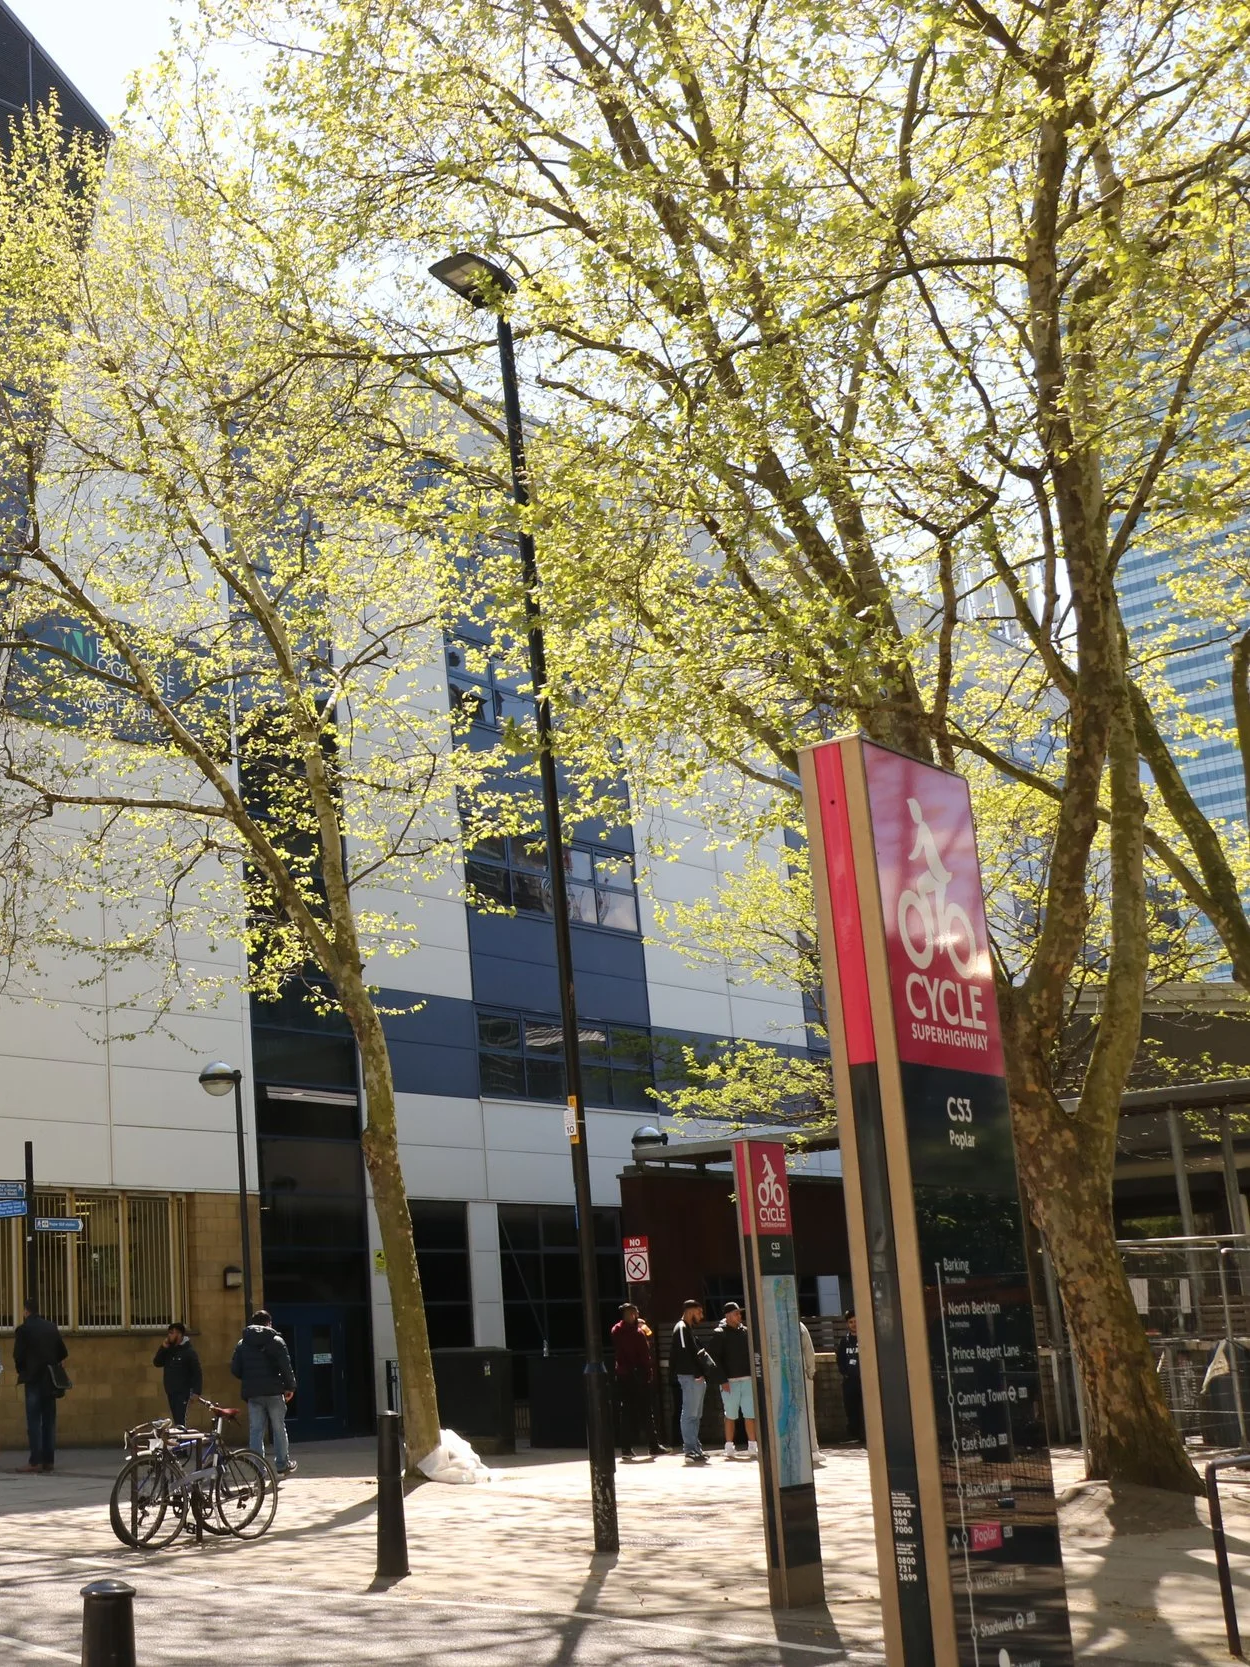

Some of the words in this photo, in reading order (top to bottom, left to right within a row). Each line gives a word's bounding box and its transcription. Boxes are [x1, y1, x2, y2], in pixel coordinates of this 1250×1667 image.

[905, 972, 987, 1031] CYCLE
[911, 1022, 988, 1052] SUPERHIGHWAY
[946, 1096, 973, 1123] CS3
[566, 1125, 575, 1134] 10
[949, 1129, 976, 1150] Poplar
[759, 1207, 786, 1222] CYCLE
[624, 1246, 647, 1254] SMOKING
[629, 1238, 641, 1247] NO
[771, 1242, 780, 1250] CS3
[943, 1257, 970, 1274] Barking
[948, 1301, 970, 1315] North
[971, 1301, 1001, 1314] Beckton
[952, 1346, 975, 1360] Prince
[976, 1344, 1002, 1362] Regent
[1003, 1343, 1020, 1357] Lane
[957, 1391, 987, 1407] Canning
[987, 1388, 1008, 1403] Town
[961, 1437, 977, 1451] East
[979, 1434, 997, 1448] India
[966, 1480, 1000, 1497] Blackwall
[893, 1509, 911, 1517] 0845
[894, 1518, 908, 1526] 300
[895, 1526, 913, 1534] 7000
[974, 1527, 998, 1545] Poplar
[897, 1557, 916, 1565] 0800
[899, 1565, 912, 1573] 731
[899, 1573, 917, 1581] 3699
[975, 1571, 1014, 1590] Westferry
[980, 1616, 1014, 1638] Shadwell
